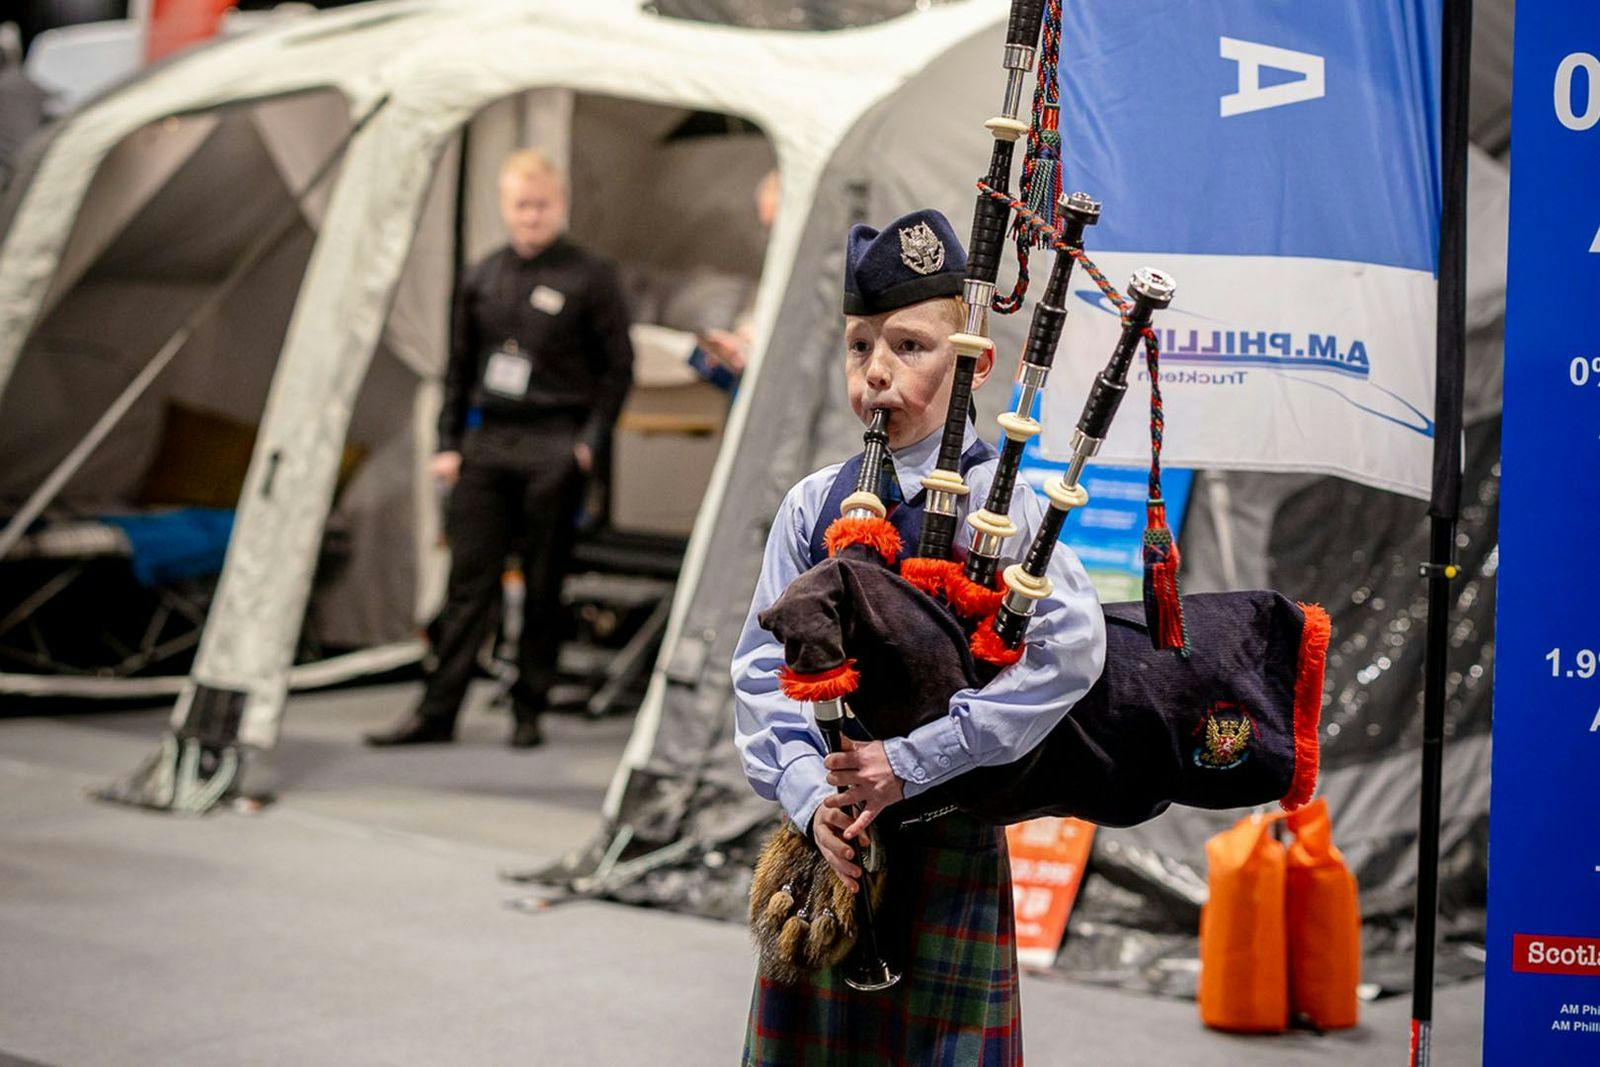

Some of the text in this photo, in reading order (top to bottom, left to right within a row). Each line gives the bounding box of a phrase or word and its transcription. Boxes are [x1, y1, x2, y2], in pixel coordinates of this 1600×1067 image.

[1569, 356, 1600, 387] 0
[1545, 647, 1600, 680] 1.9
[1528, 941, 1600, 967] Scotl
[1560, 1003, 1579, 1015] AM
[1551, 1020, 1571, 1032] AM
